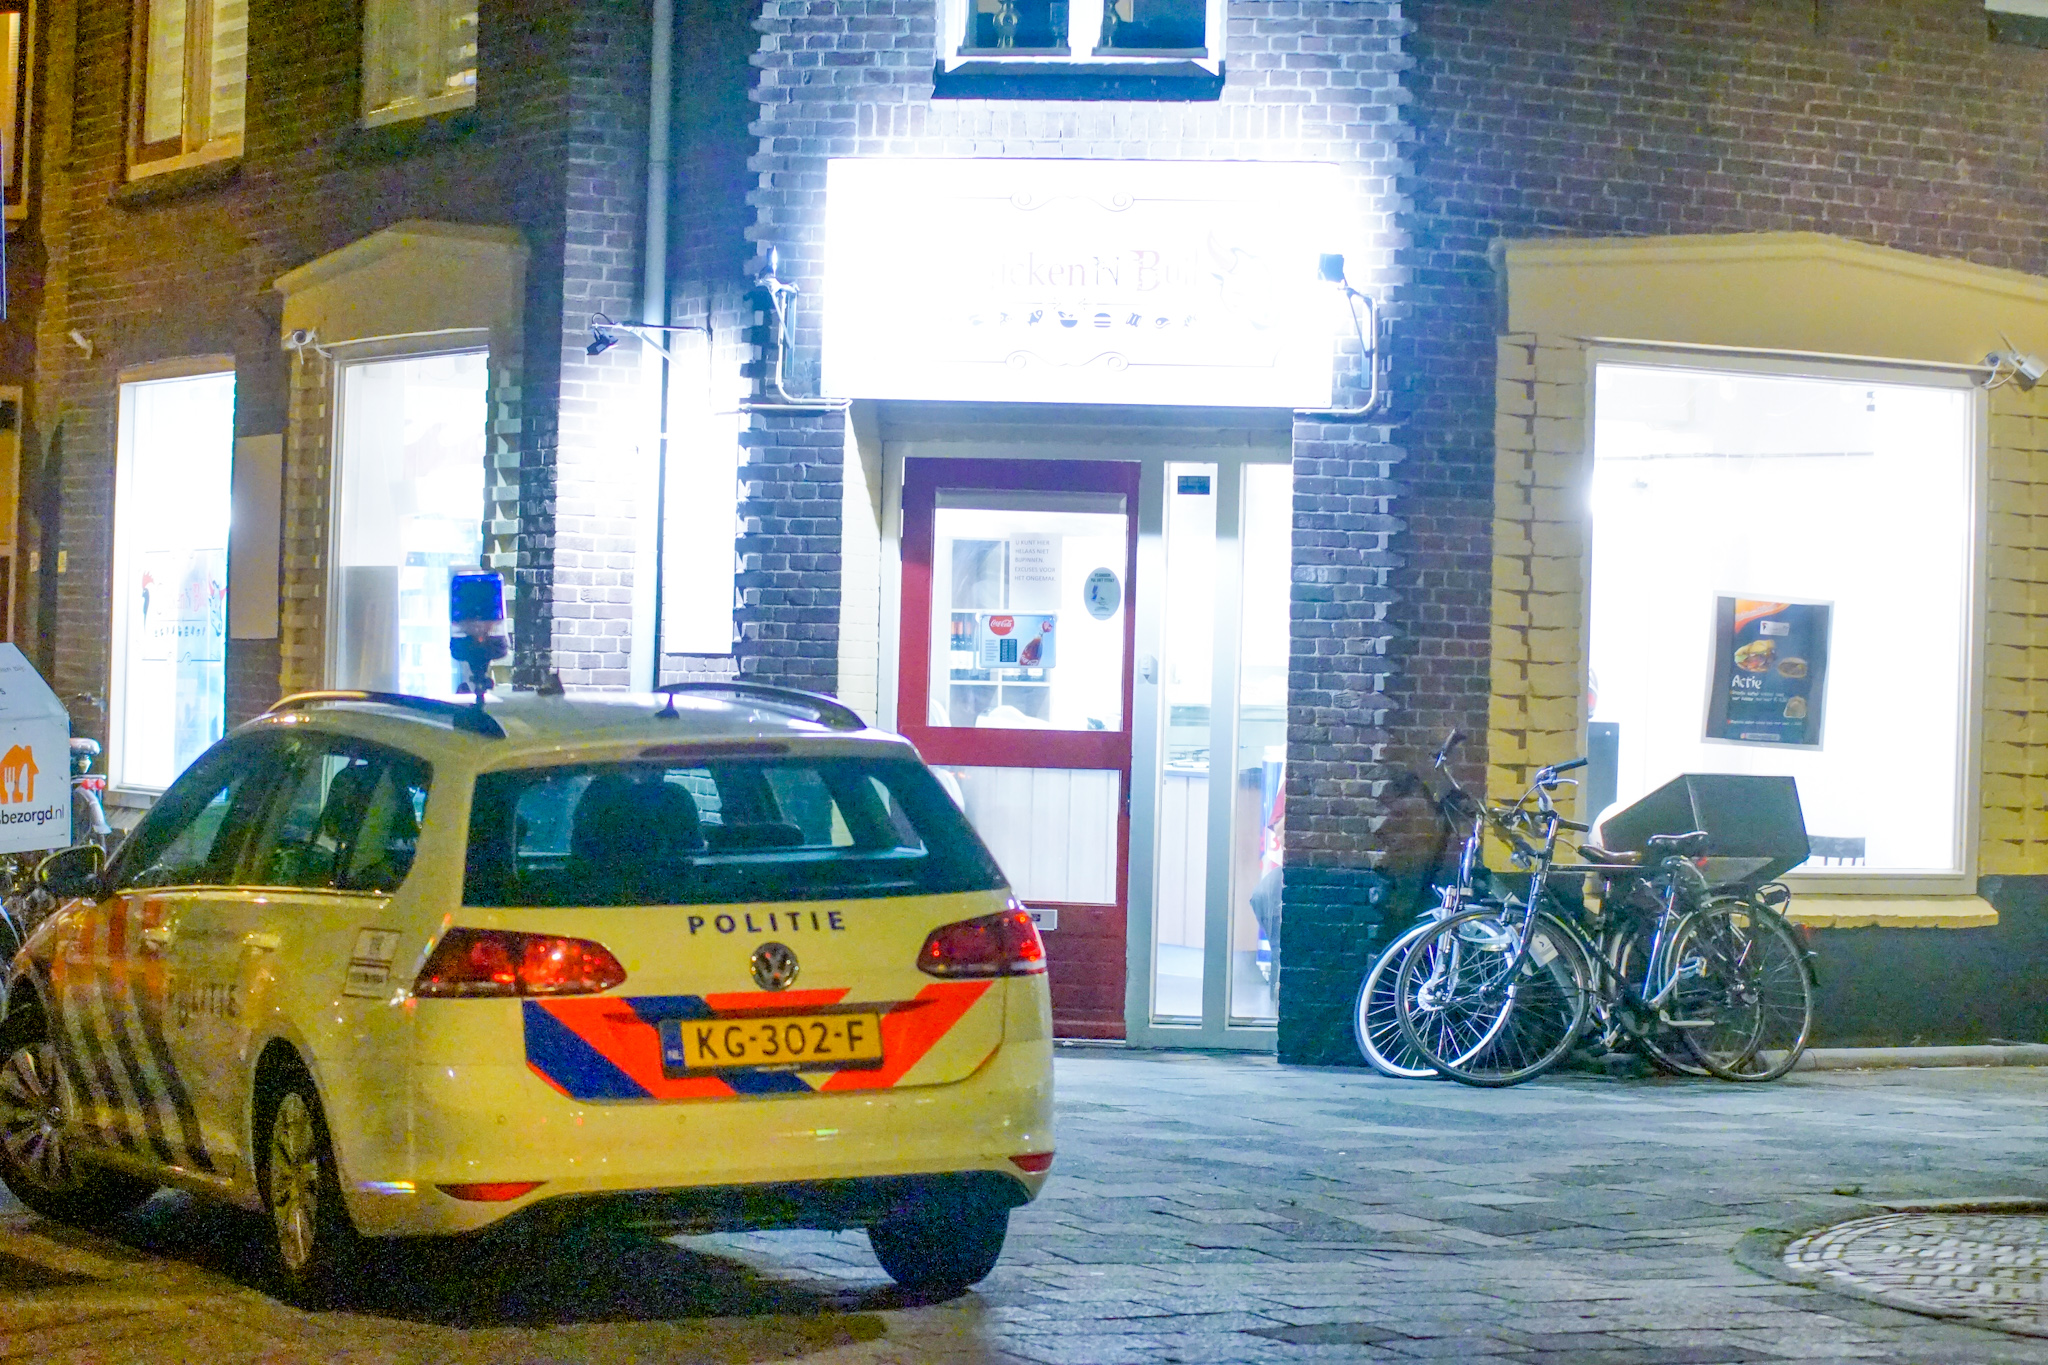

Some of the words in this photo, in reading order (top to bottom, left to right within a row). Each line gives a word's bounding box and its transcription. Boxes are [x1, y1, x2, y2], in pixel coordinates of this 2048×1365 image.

[1731, 674, 1762, 689] Actie
[687, 910, 846, 935] POLITIE
[696, 1019, 865, 1060] KG-302-F
